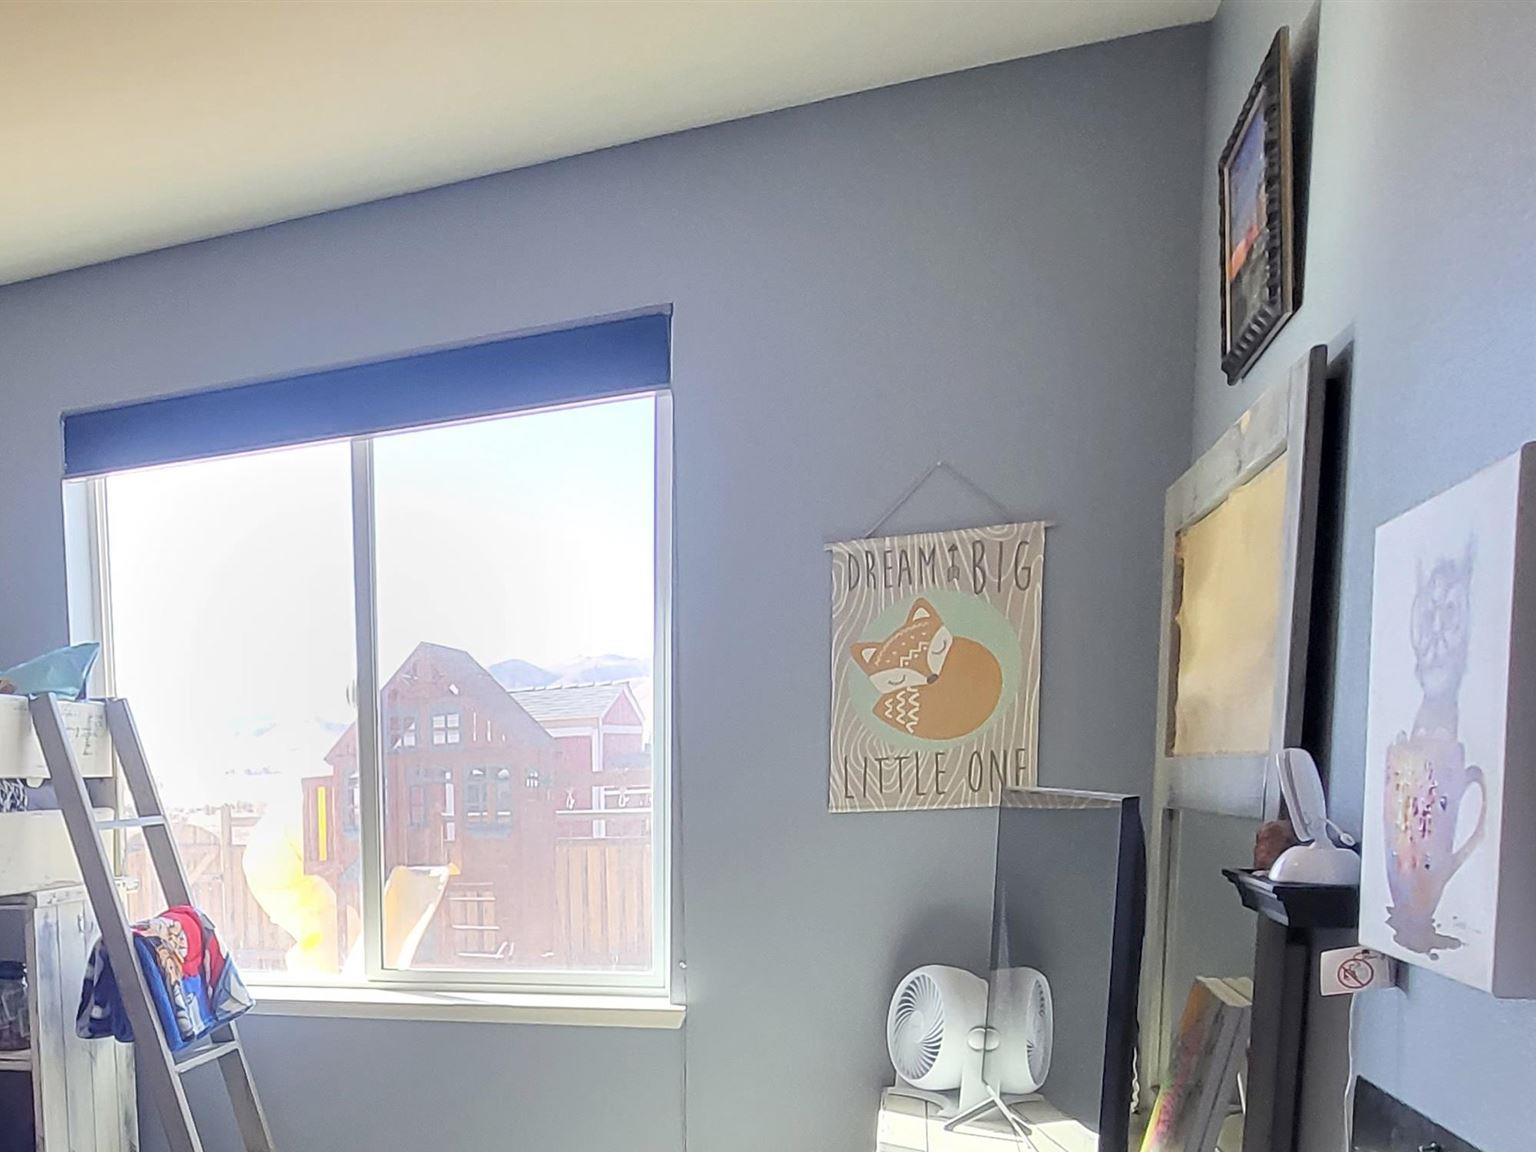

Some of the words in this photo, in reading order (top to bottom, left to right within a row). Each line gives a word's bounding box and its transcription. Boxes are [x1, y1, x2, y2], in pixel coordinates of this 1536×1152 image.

[847, 545, 937, 592] DREAM
[971, 539, 1032, 595] BIG
[843, 750, 947, 799] LITTLE
[968, 747, 1028, 793] ONE
